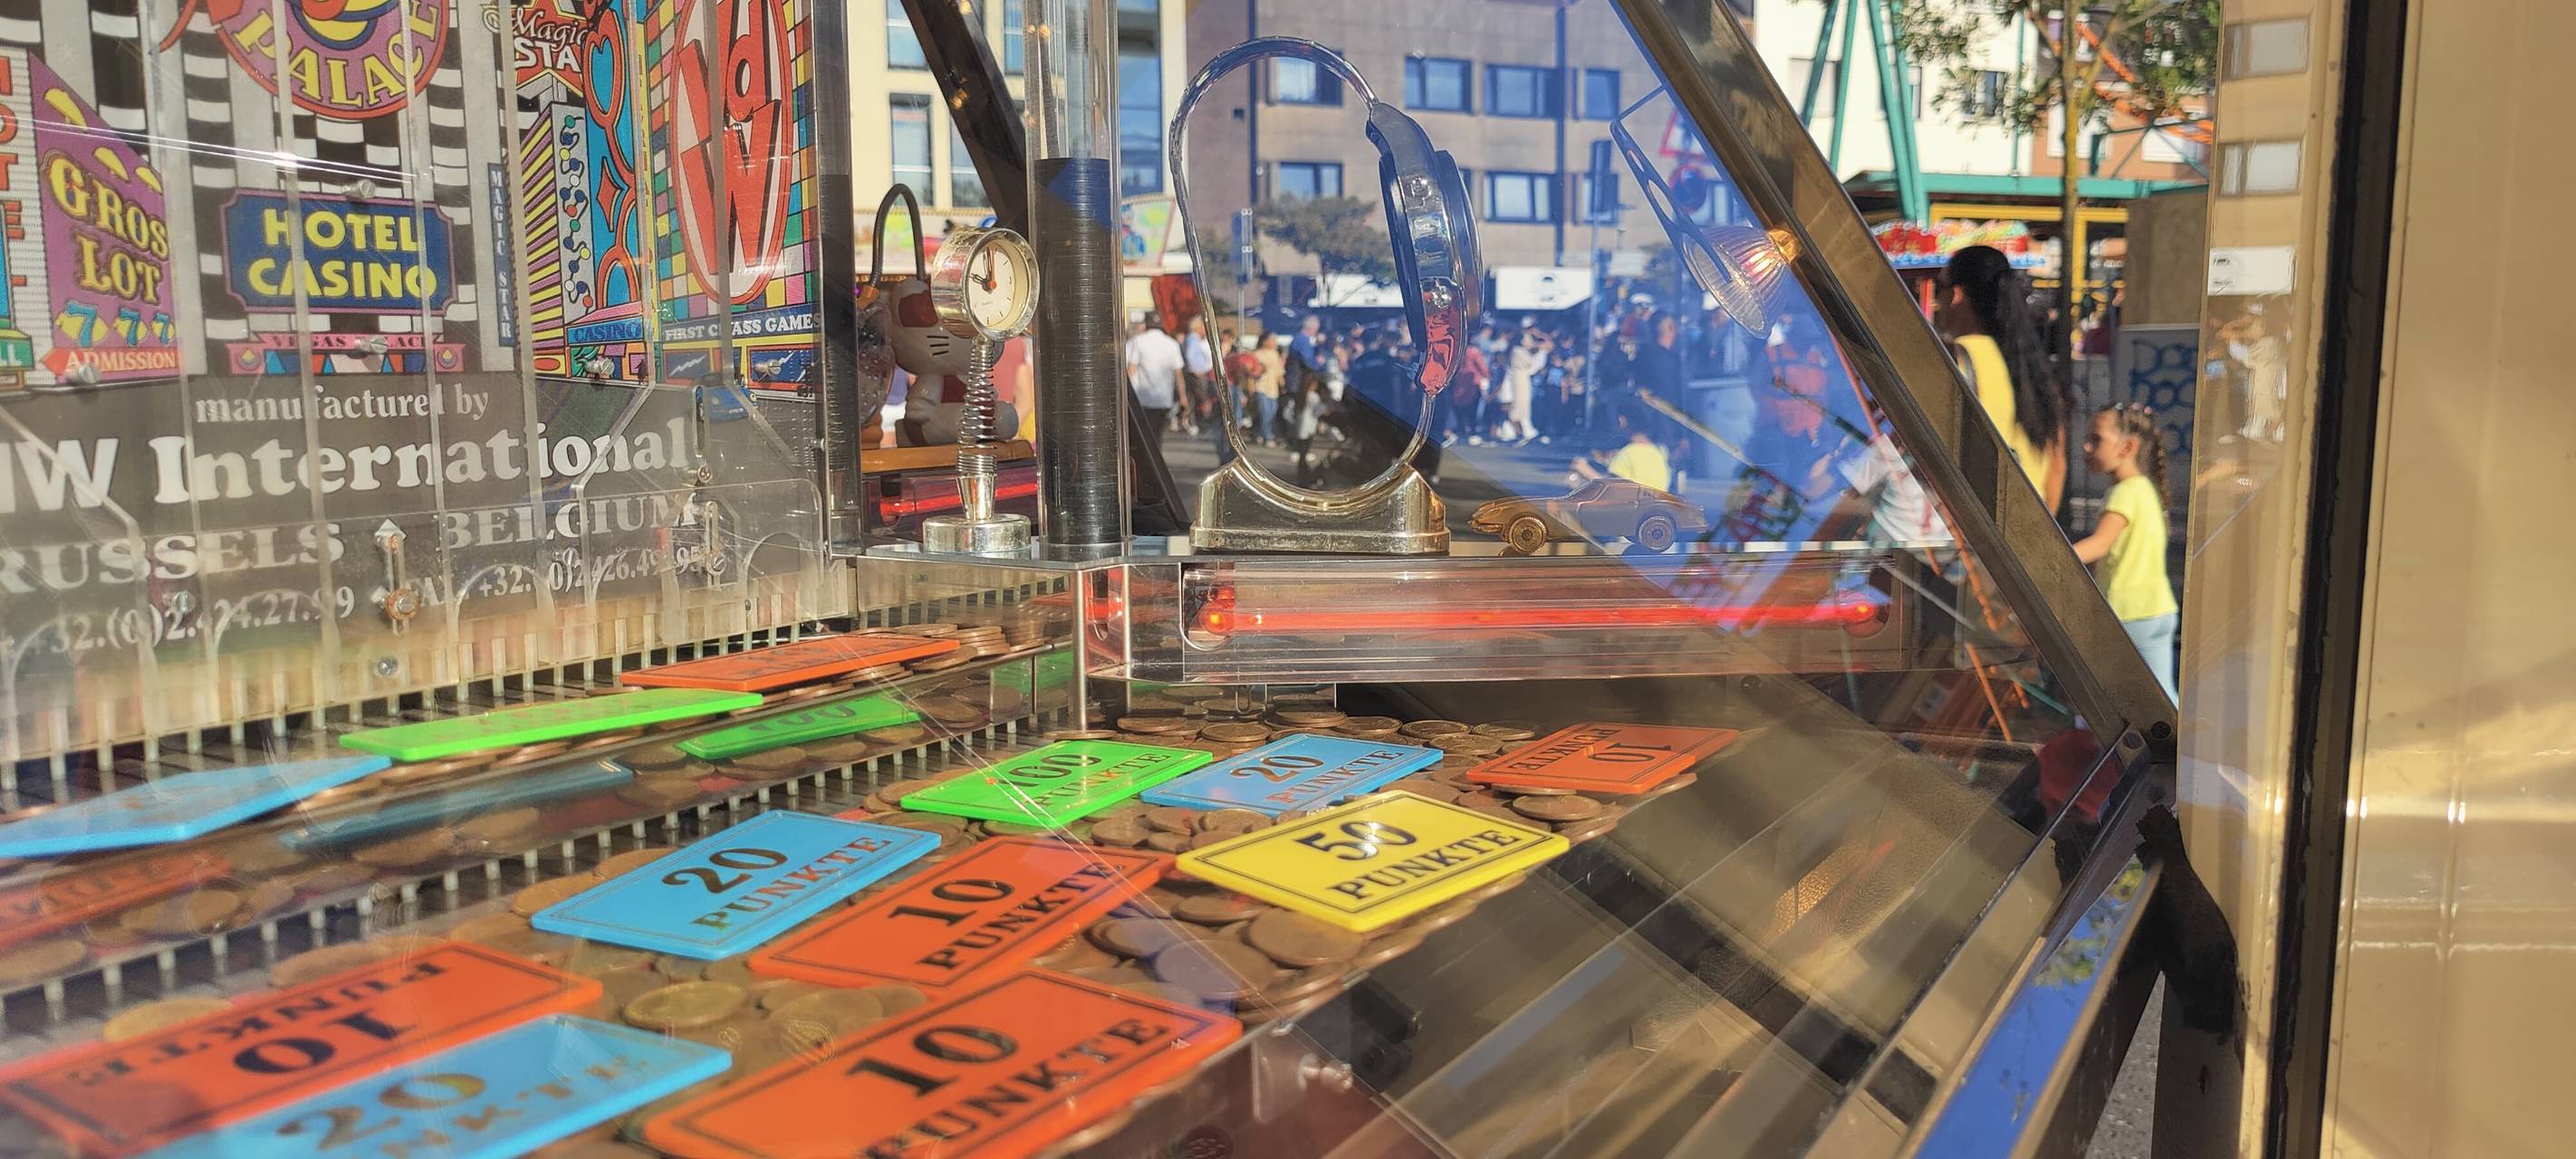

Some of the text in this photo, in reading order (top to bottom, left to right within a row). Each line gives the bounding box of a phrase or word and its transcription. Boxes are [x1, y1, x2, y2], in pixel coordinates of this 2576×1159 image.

[233, 1, 438, 107] PALACE
[511, 6, 589, 53] Magic
[47, 157, 169, 261] GROS
[264, 208, 419, 252] HOTEL
[491, 170, 505, 255] MAGIC
[74, 233, 161, 304] LOT
[248, 257, 437, 299] CASINO
[498, 272, 513, 338] STAR
[664, 325, 705, 341] FIRST
[708, 319, 763, 339] CASS
[573, 320, 642, 343] CASINO
[65, 350, 176, 372] ADMISSION
[195, 382, 490, 423] manufactured by
[149, 417, 689, 504] International
[995, 753, 1102, 788] 100
[1231, 755, 1325, 783] 20
[1507, 727, 1624, 771] PUNKTE
[1588, 742, 1672, 762] 10
[1024, 752, 1172, 807] PUNKTE
[1265, 750, 1406, 804] PUNKTE
[1293, 820, 1418, 861] 50
[1325, 829, 1522, 900] PUNKTE
[662, 848, 788, 894] 20
[690, 837, 895, 930] PUNKTE
[888, 878, 1015, 927] 10
[915, 860, 1123, 970] PUNKTE
[233, 1006, 417, 1074] 10
[844, 1025, 1020, 1098] 10
[275, 1073, 486, 1151] 20
